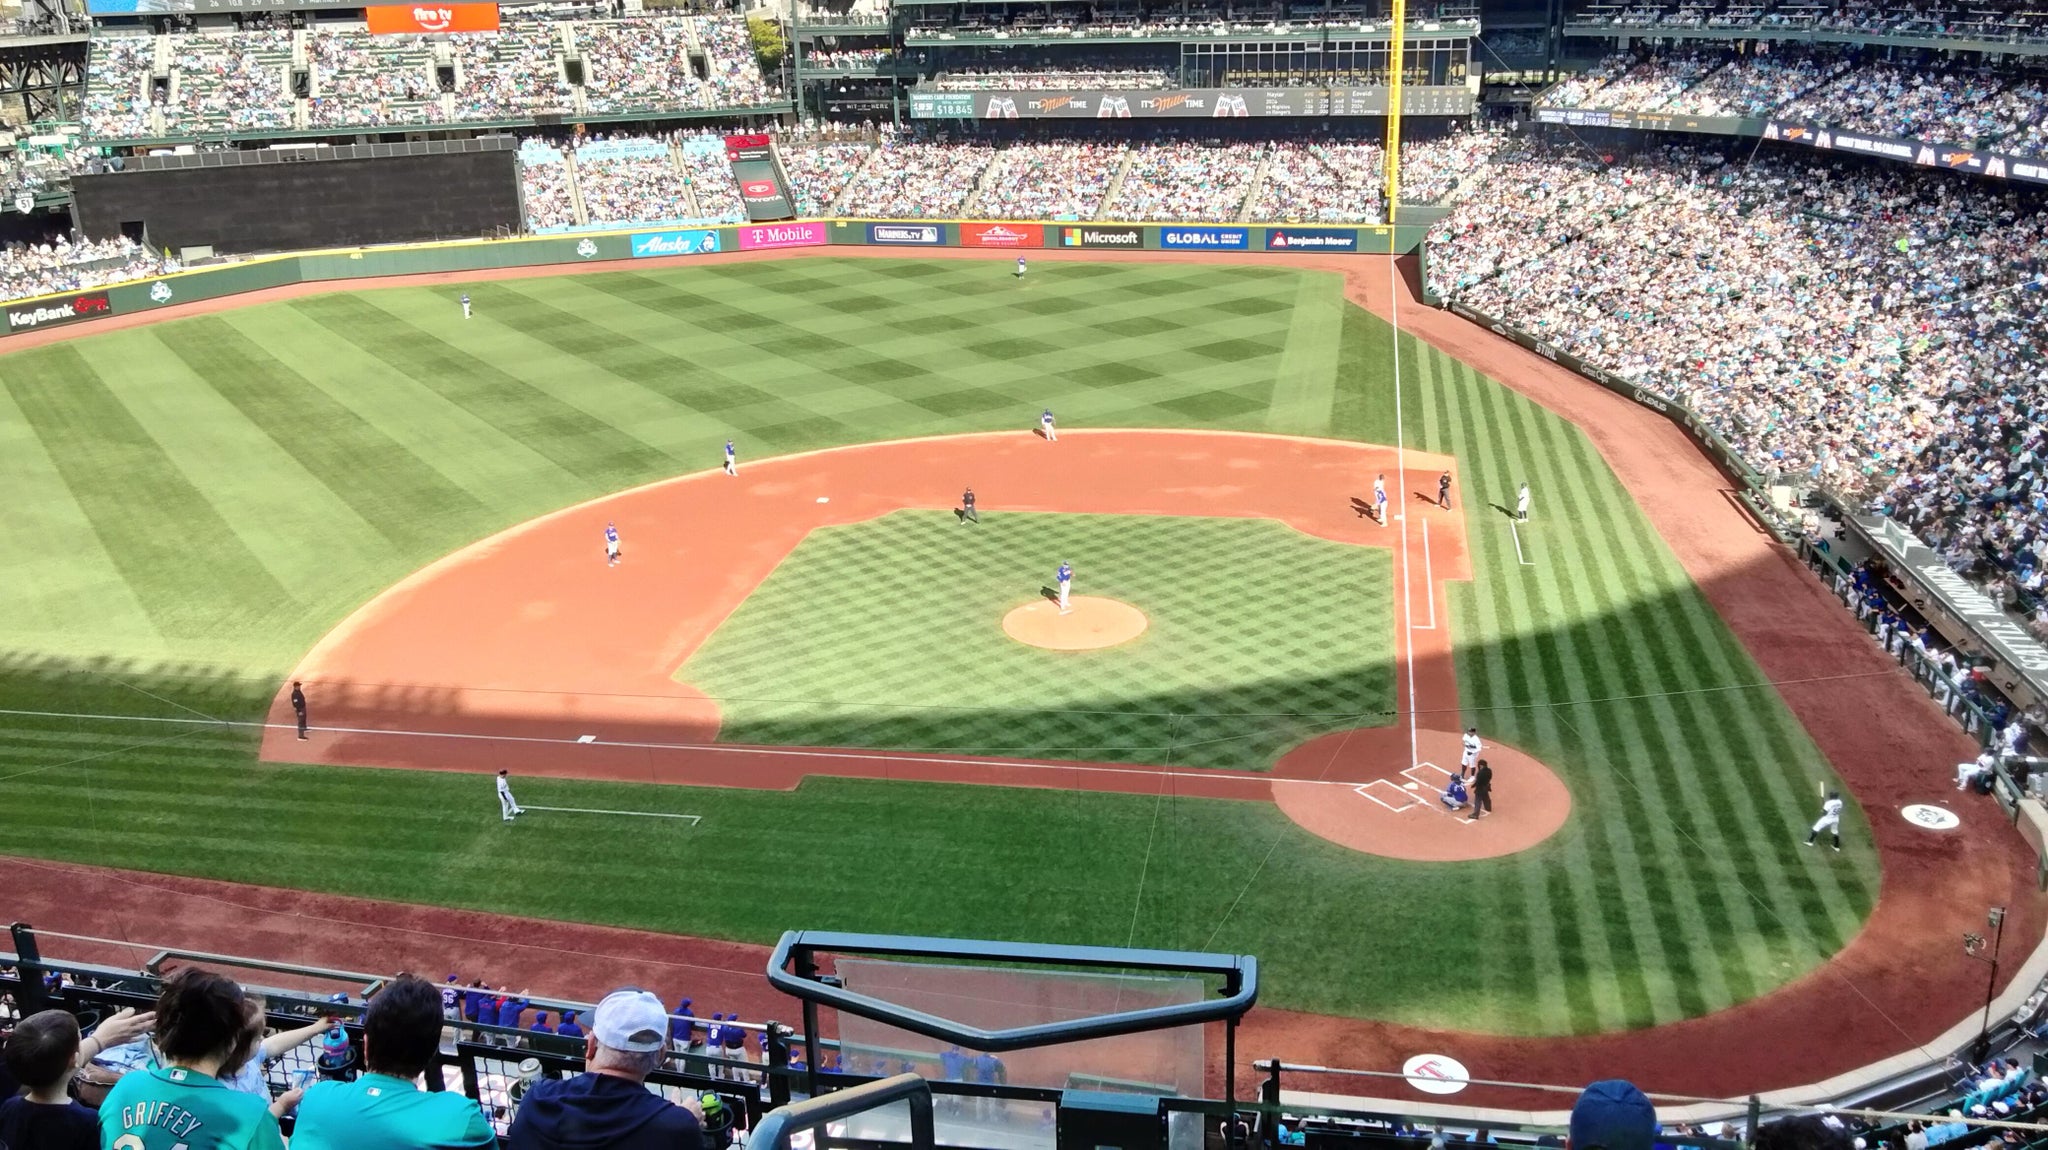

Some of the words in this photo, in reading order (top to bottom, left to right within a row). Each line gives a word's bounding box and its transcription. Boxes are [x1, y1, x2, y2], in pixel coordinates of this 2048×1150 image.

[413, 8, 437, 21] fire
[438, 9, 452, 21] tv
[1069, 101, 1088, 109] TIME
[1185, 100, 1205, 108] TIME
[937, 105, 973, 115] $18,845
[21, 199, 31, 209] 51
[752, 229, 764, 243] T
[767, 227, 813, 242] Mobile
[1084, 231, 1138, 243] Microsoft
[1166, 233, 1219, 244] GLOBAL
[636, 236, 691, 253] Alaska
[1287, 236, 1324, 247] Benjamin
[1325, 236, 1352, 245] Moore
[9, 303, 76, 327] KeyBank
[1535, 342, 1558, 361] STIHL
[710, 1028, 718, 1039] 8
[122, 1100, 203, 1140] GRIFFEY
